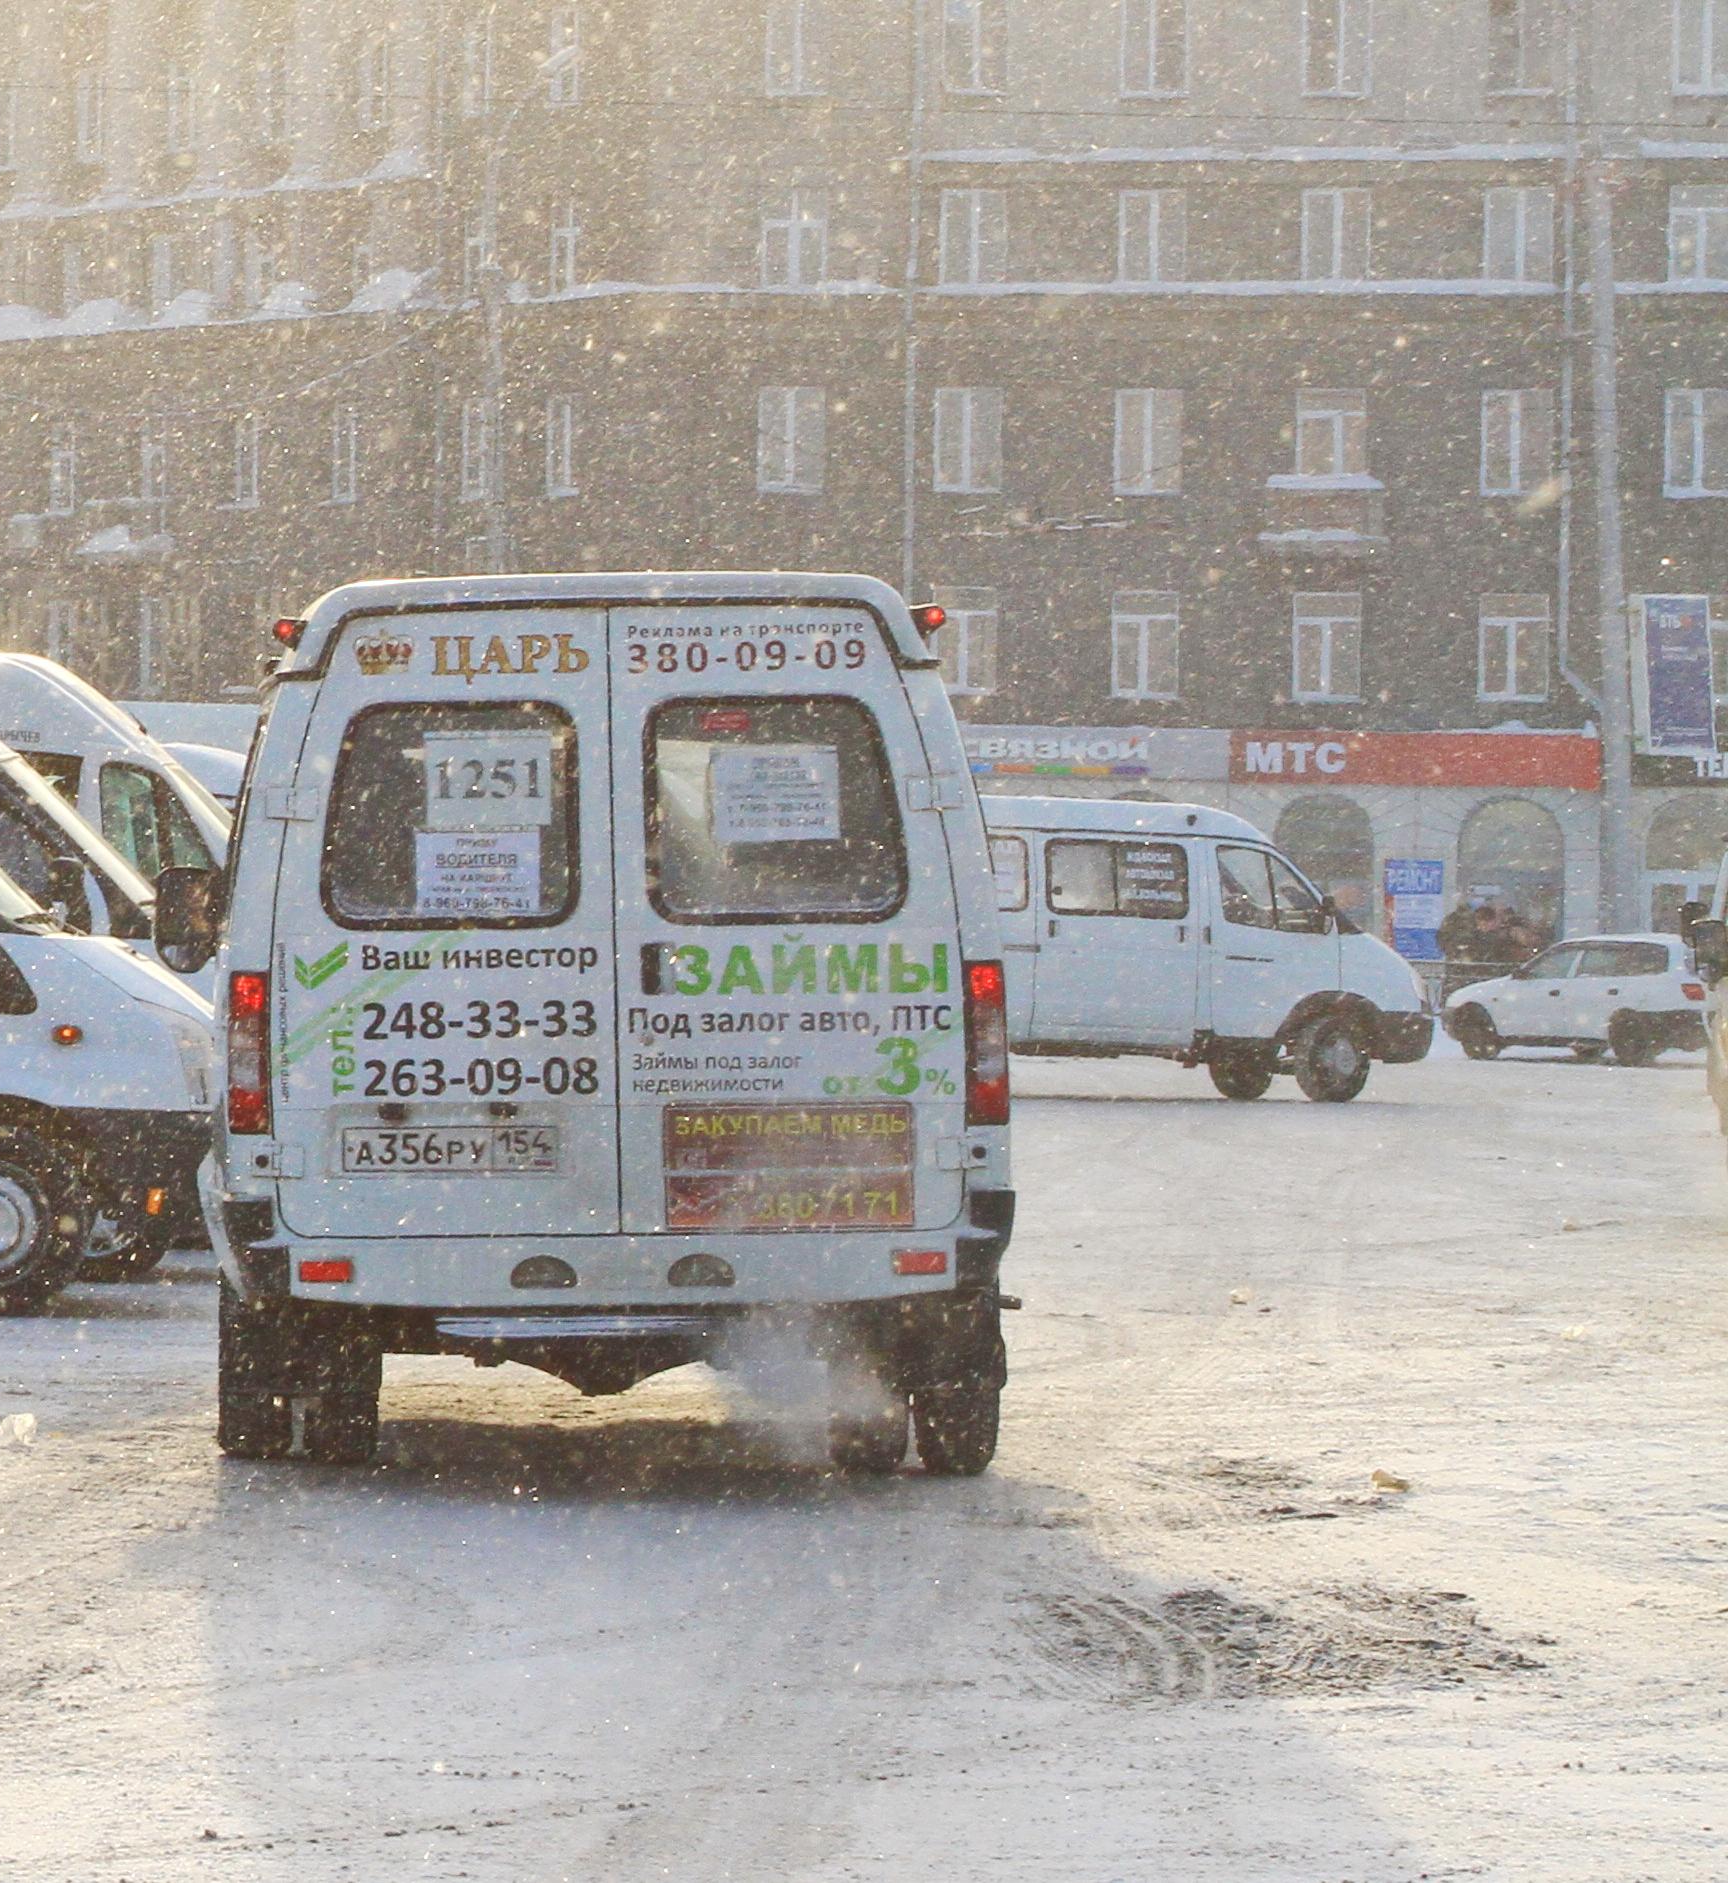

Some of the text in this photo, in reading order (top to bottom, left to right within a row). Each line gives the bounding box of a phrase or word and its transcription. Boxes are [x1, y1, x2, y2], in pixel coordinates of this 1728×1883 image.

[626, 620, 865, 640] Реклама на транспорте
[429, 633, 591, 686] ЦАРЬ
[627, 639, 867, 674] 380-09-09
[1245, 741, 1346, 773] МТС
[433, 758, 544, 799] 1251
[435, 852, 518, 867] ВОДИТЕЛЯ
[361, 944, 599, 975] Ваш инвестор
[673, 932, 949, 996] ЗАЙМЫ
[362, 999, 597, 1041] 248-33-33
[628, 1005, 952, 1038] Под залог авто, ПТС
[364, 1057, 600, 1097] 263-09-08
[631, 1052, 802, 1072] Займы под залог
[632, 1077, 784, 1095] недвижимости
[674, 1112, 908, 1138] ЗАКУПАЕМ МЕДЬ
[498, 1129, 553, 1155] 154
